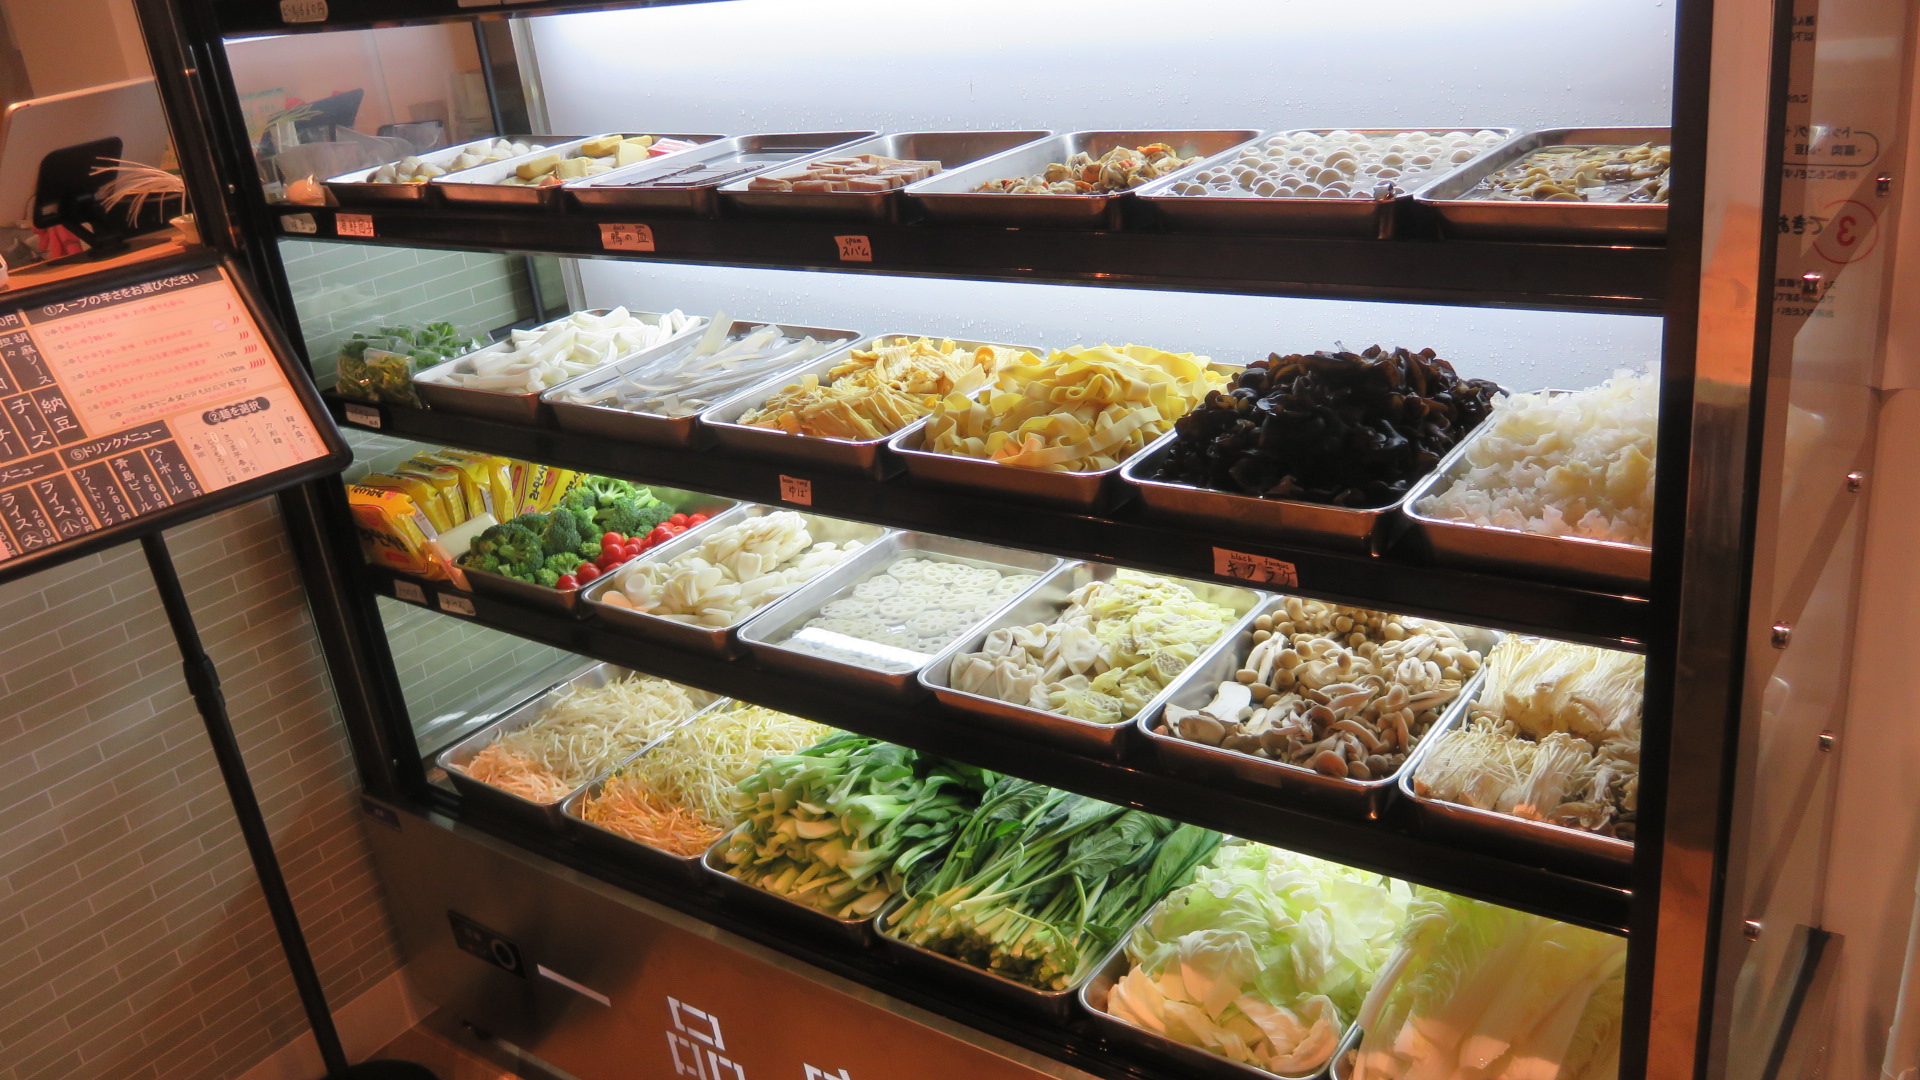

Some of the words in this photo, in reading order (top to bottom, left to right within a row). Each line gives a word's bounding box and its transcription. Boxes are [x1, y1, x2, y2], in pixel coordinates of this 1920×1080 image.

[843, 246, 869, 257] スパム
[11, 399, 51, 448] チーズ
[41, 396, 78, 433] 納豆
[789, 486, 808, 498] ゆば
[1227, 560, 1297, 585] キクラゲ
[1230, 552, 1254, 563] black
[1264, 558, 1290, 571] fungus
